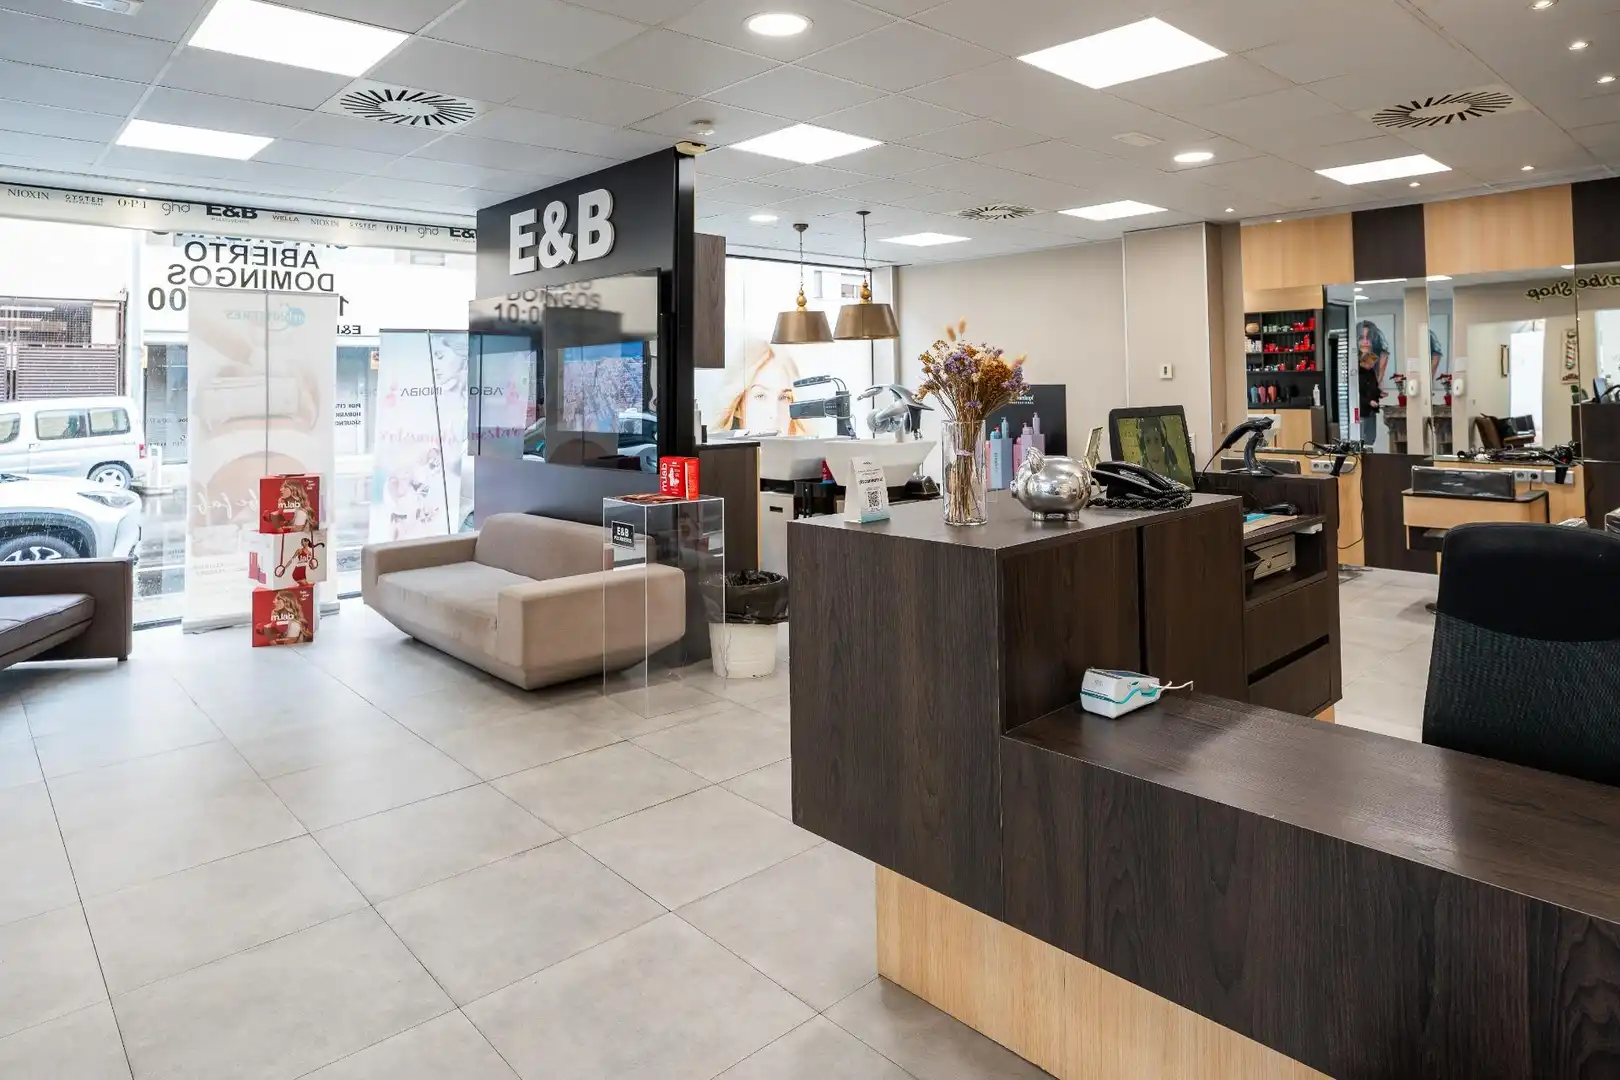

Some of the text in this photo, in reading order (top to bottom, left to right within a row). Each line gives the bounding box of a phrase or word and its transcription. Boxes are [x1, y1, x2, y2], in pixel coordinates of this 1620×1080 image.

[8, 188, 49, 200] NIOXIN
[161, 201, 190, 216] ghd
[206, 204, 258, 219] E&B
[272, 214, 300, 222] WELLA
[309, 217, 338, 227] NIOXIN
[417, 226, 439, 239] ghd
[509, 188, 616, 276] E&B
[616, 526, 630, 538] E&B
